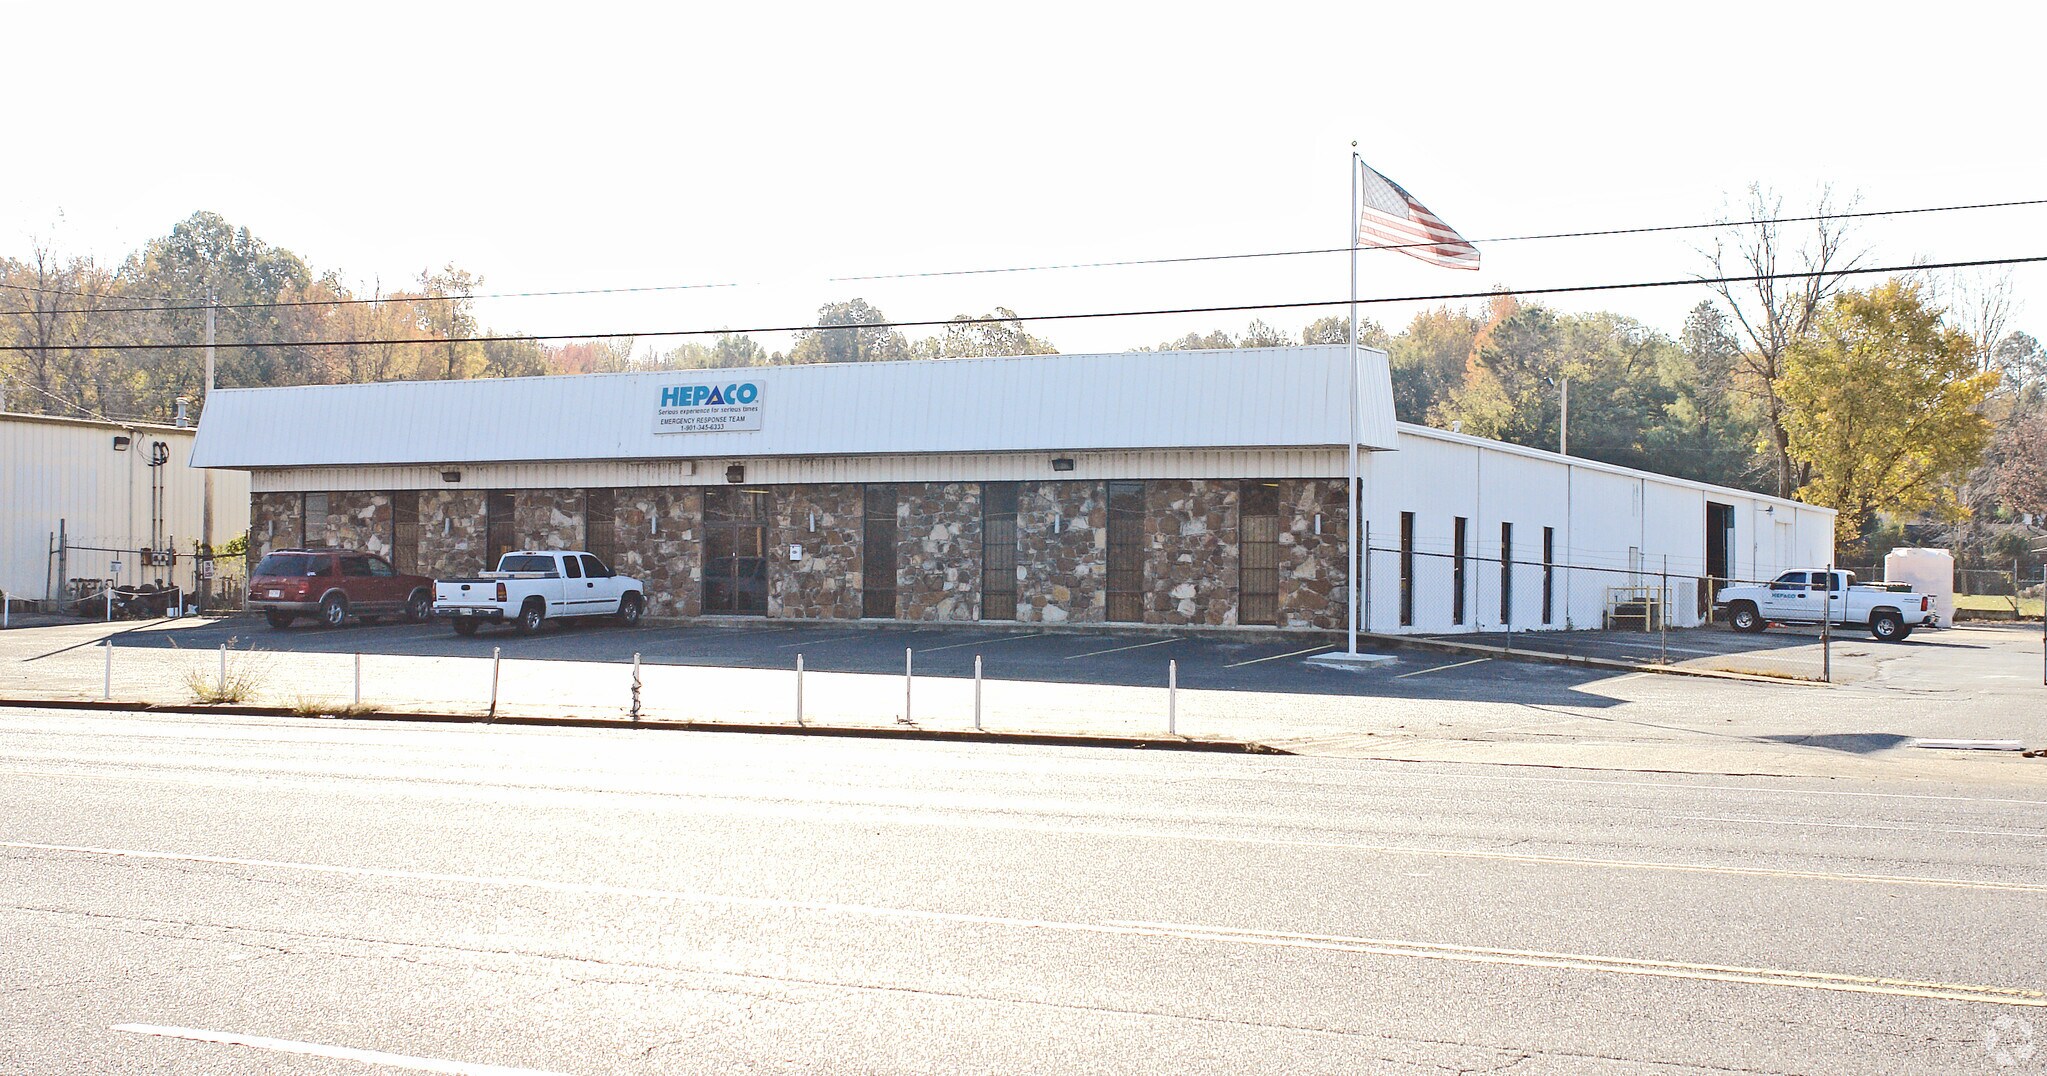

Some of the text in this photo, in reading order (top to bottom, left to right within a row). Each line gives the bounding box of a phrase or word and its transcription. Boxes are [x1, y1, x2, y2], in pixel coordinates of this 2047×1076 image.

[661, 383, 758, 407] HEPACO
[658, 408, 678, 416] Serious
[660, 417, 695, 425] EMERGENCY
[696, 416, 727, 424] RESPONSE
